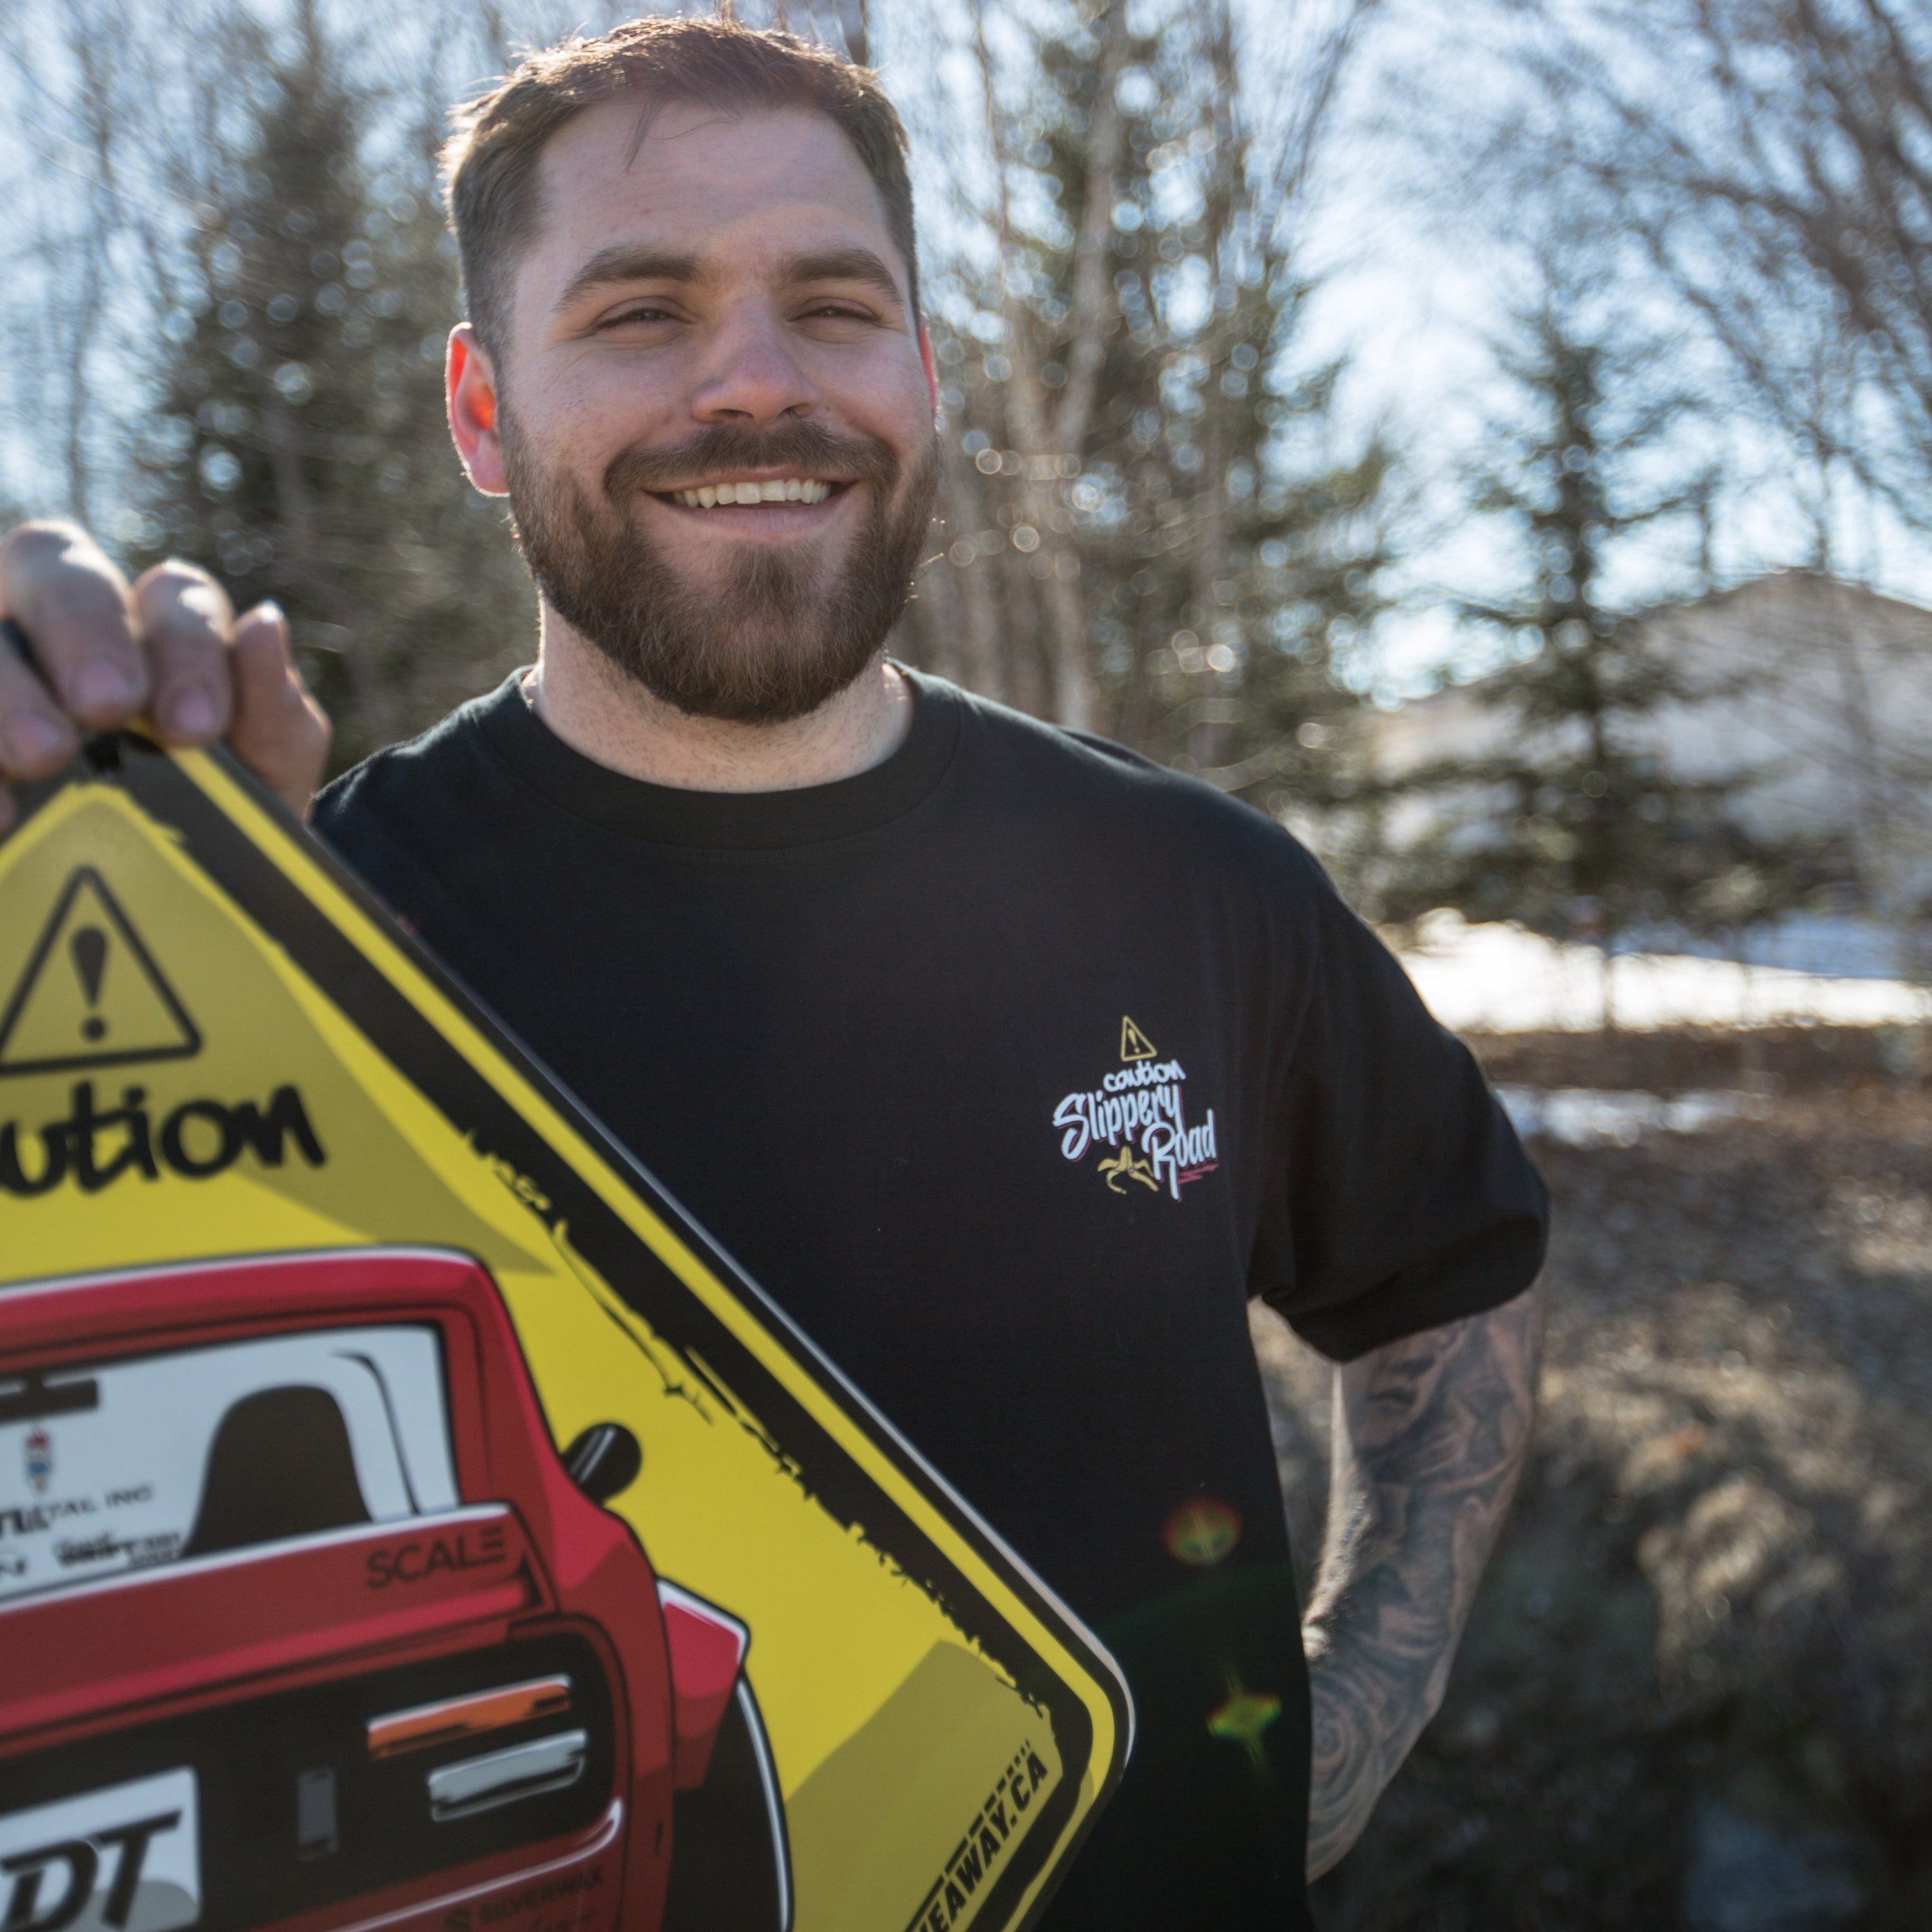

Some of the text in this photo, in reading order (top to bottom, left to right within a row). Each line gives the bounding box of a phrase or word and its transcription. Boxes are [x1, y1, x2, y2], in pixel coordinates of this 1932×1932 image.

[1103, 1059, 1187, 1092] caution
[0, 1079, 327, 1199] ution
[1052, 1084, 1185, 1161] Slippery
[1141, 1108, 1218, 1202] Road
[365, 1524, 506, 1589] SCALE
[918, 1750, 1049, 1932] EAWAY.CA
